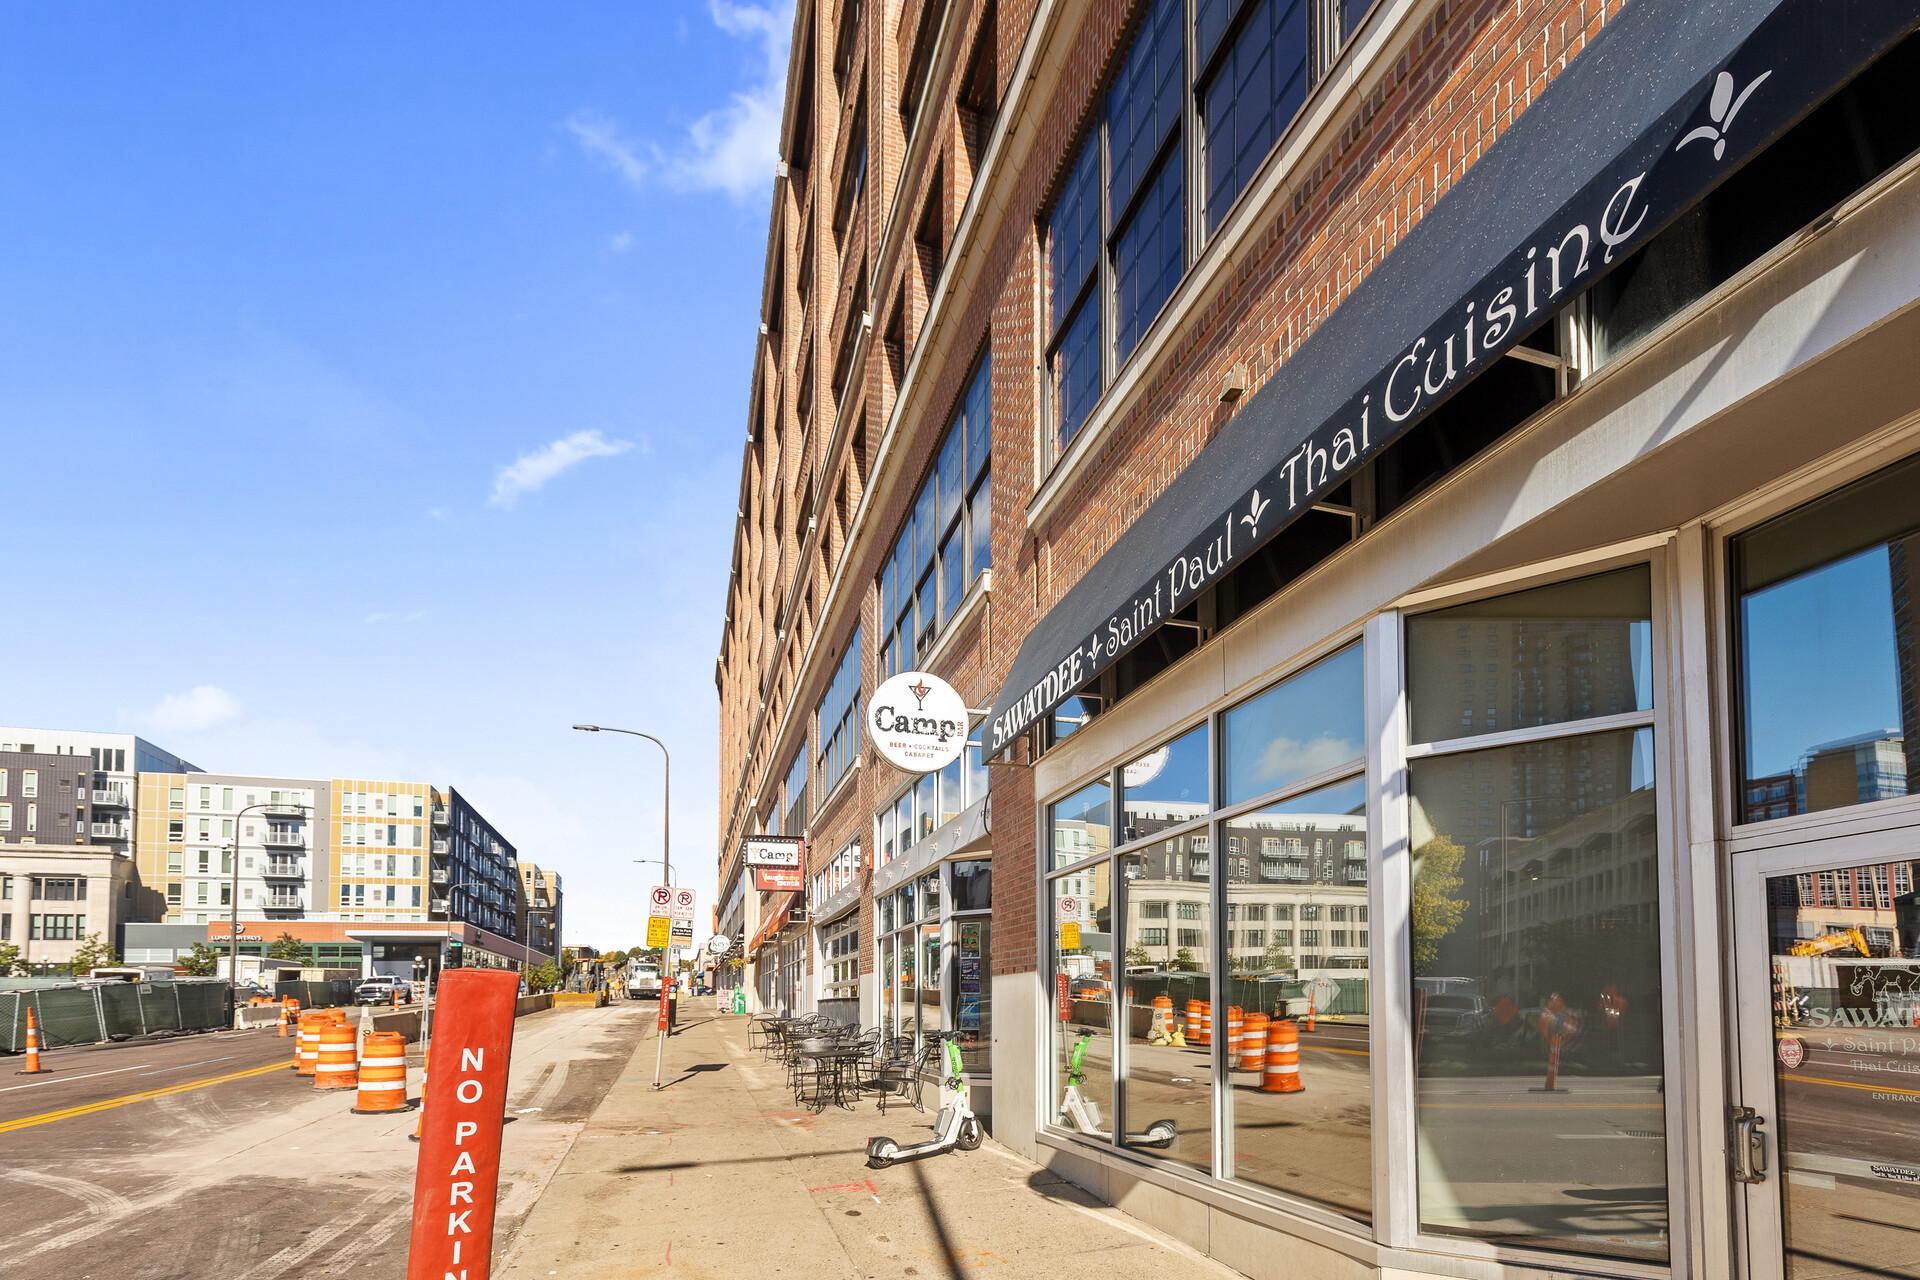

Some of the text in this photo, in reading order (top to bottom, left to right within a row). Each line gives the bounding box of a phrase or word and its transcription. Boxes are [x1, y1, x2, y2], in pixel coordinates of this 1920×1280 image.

[992, 171, 1649, 751] SAWATDEE Saint Paul Thai Cuisine
[875, 705, 956, 742] Camp
[904, 751, 935, 759] CABARET
[914, 744, 949, 752] COCKTAILS
[759, 848, 793, 862] Camp
[1843, 1037, 1895, 1053] Saint
[1850, 1060, 1881, 1071] Thai
[456, 1047, 484, 1104] NO
[1873, 1165, 1916, 1176] SAWATDEE
